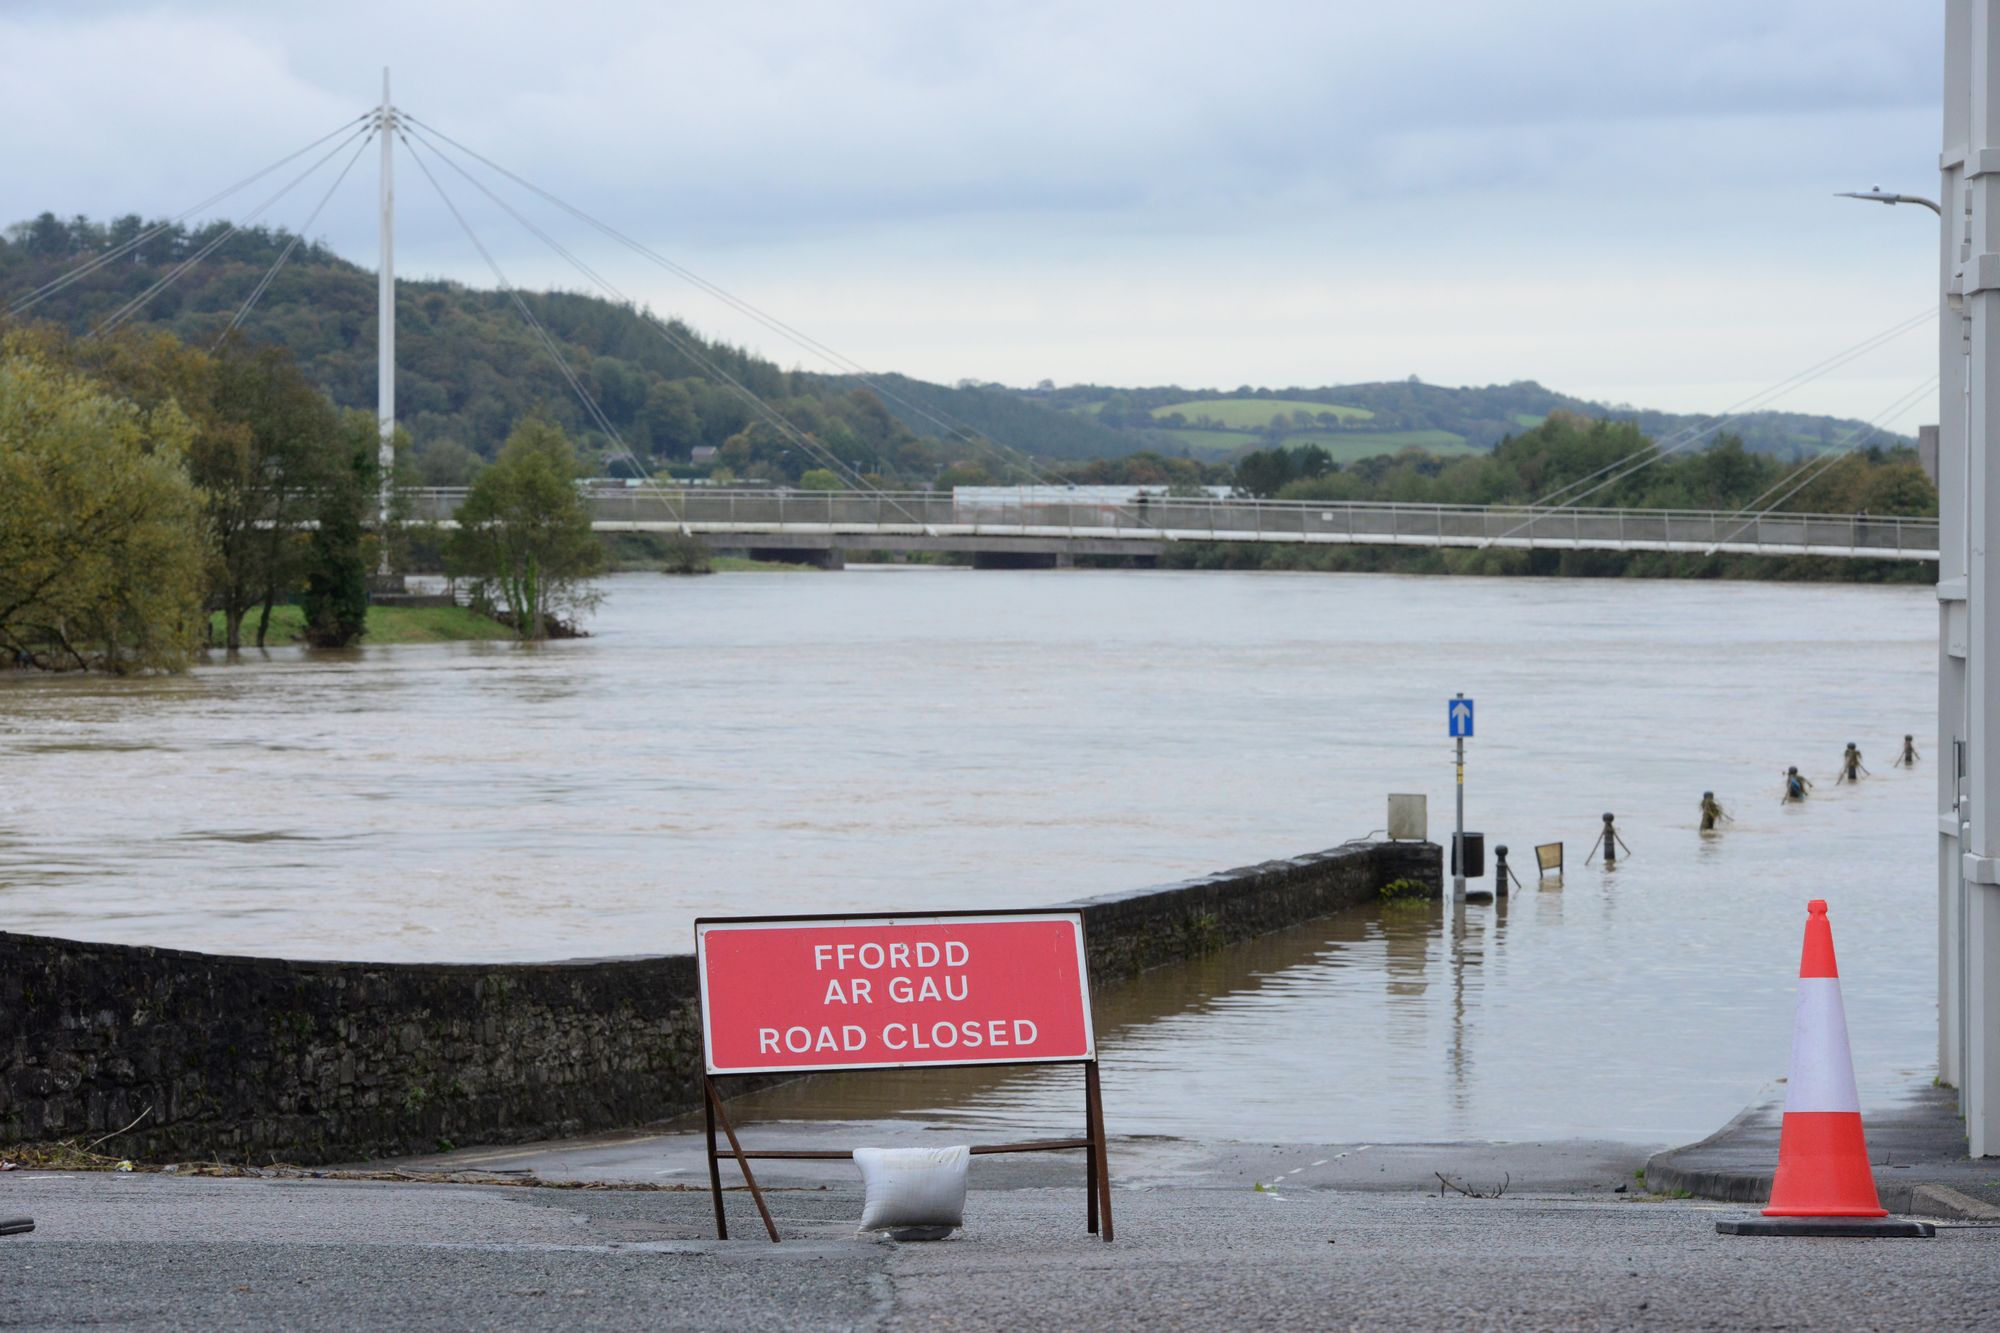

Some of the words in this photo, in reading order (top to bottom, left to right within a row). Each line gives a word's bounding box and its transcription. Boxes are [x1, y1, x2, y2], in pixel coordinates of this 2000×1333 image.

[814, 941, 970, 971] FFORDD
[823, 978, 873, 1005] AR
[888, 974, 969, 1003] GAU
[758, 1024, 867, 1054] ROAD
[882, 1019, 1038, 1050] CLOSED
